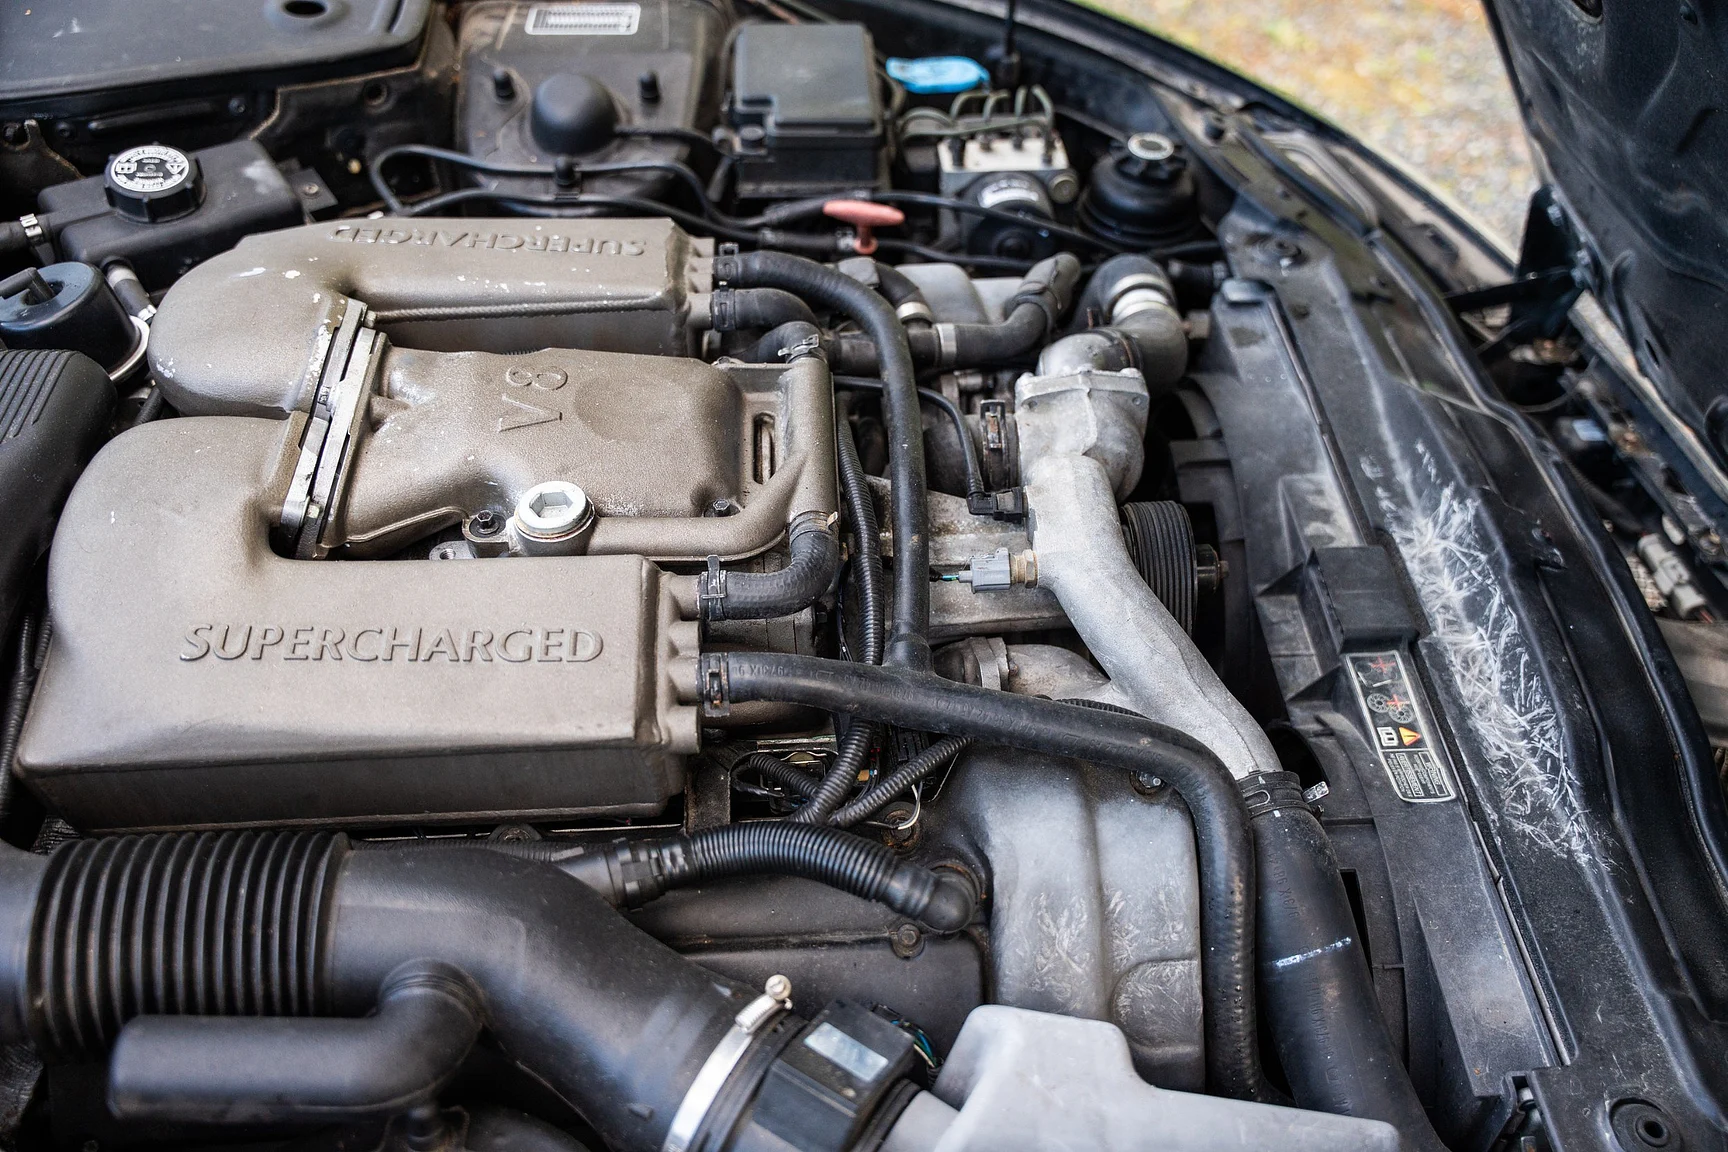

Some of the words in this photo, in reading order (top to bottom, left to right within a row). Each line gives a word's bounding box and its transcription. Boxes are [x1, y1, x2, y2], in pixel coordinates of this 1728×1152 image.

[329, 225, 647, 257] SUPERCHARGED
[498, 365, 568, 434] V8
[179, 622, 605, 663] SUPERCHARGED
